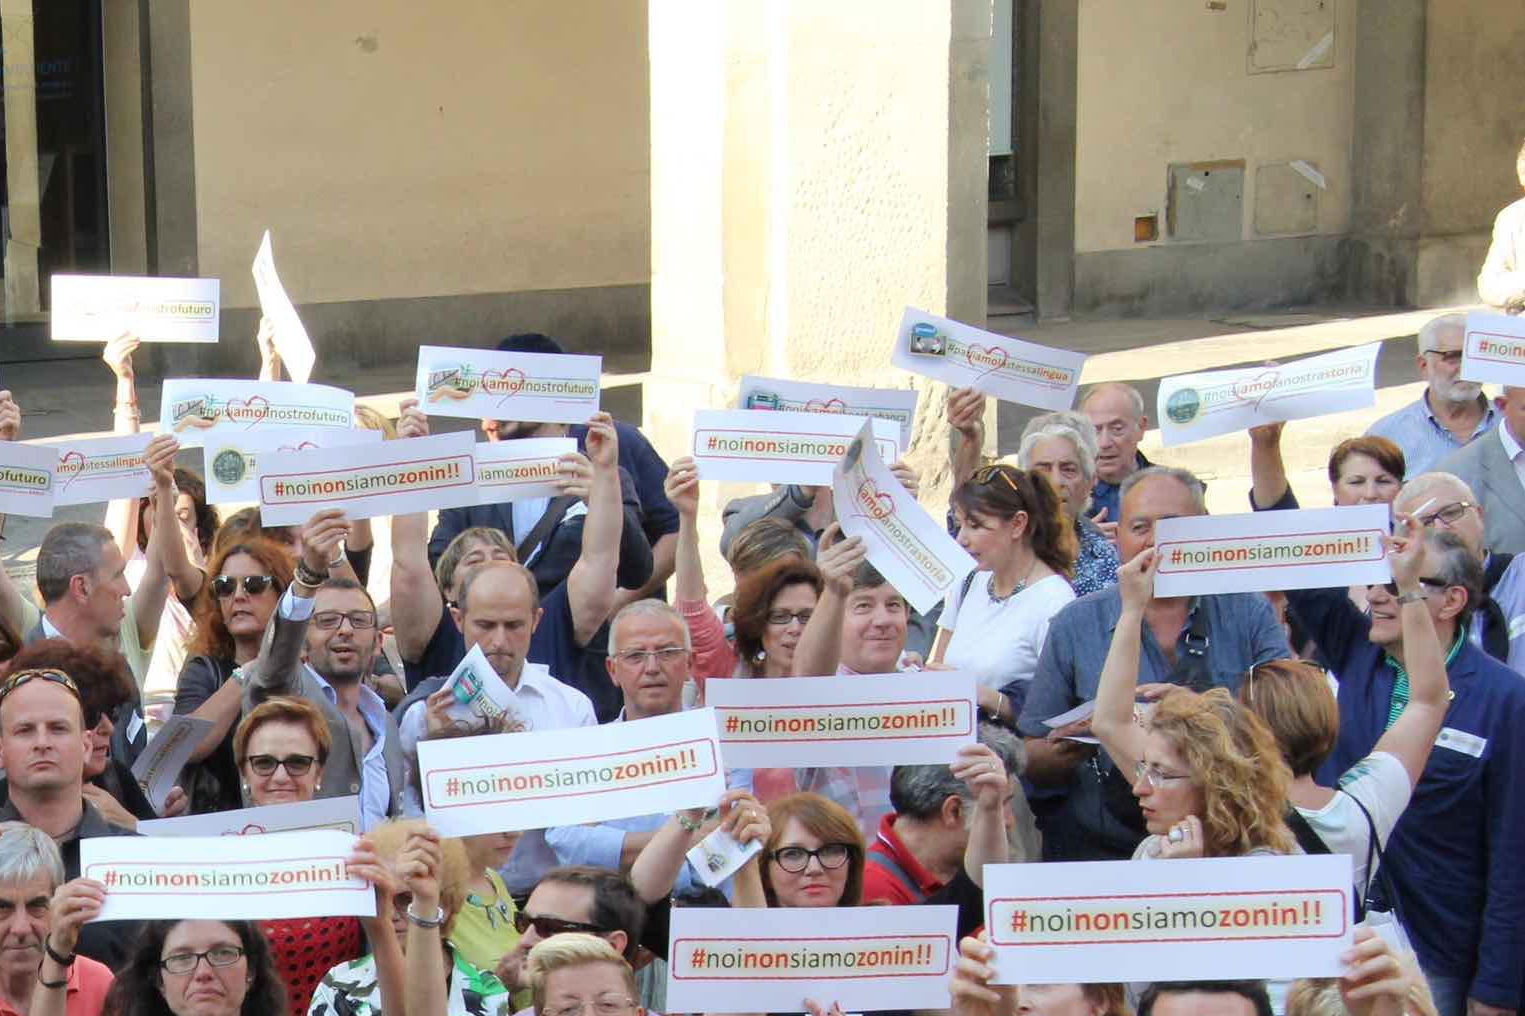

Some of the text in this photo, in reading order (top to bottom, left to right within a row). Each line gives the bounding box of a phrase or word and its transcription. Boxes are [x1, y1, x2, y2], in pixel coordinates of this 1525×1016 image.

[1478, 340, 1525, 356] #noin
[274, 463, 460, 497] #noinonsiamozonin!!
[1171, 537, 1370, 566] #noinonsiamozonin!!
[725, 708, 956, 734] #noinonsiamozonin!!
[445, 749, 698, 798] #noinonsiamozonin!!
[102, 865, 350, 889] #noinonsiamozonin!!
[1010, 901, 1323, 933] #noinonsiamozonin!!
[690, 943, 933, 970] #noinonsiamozonin!!
